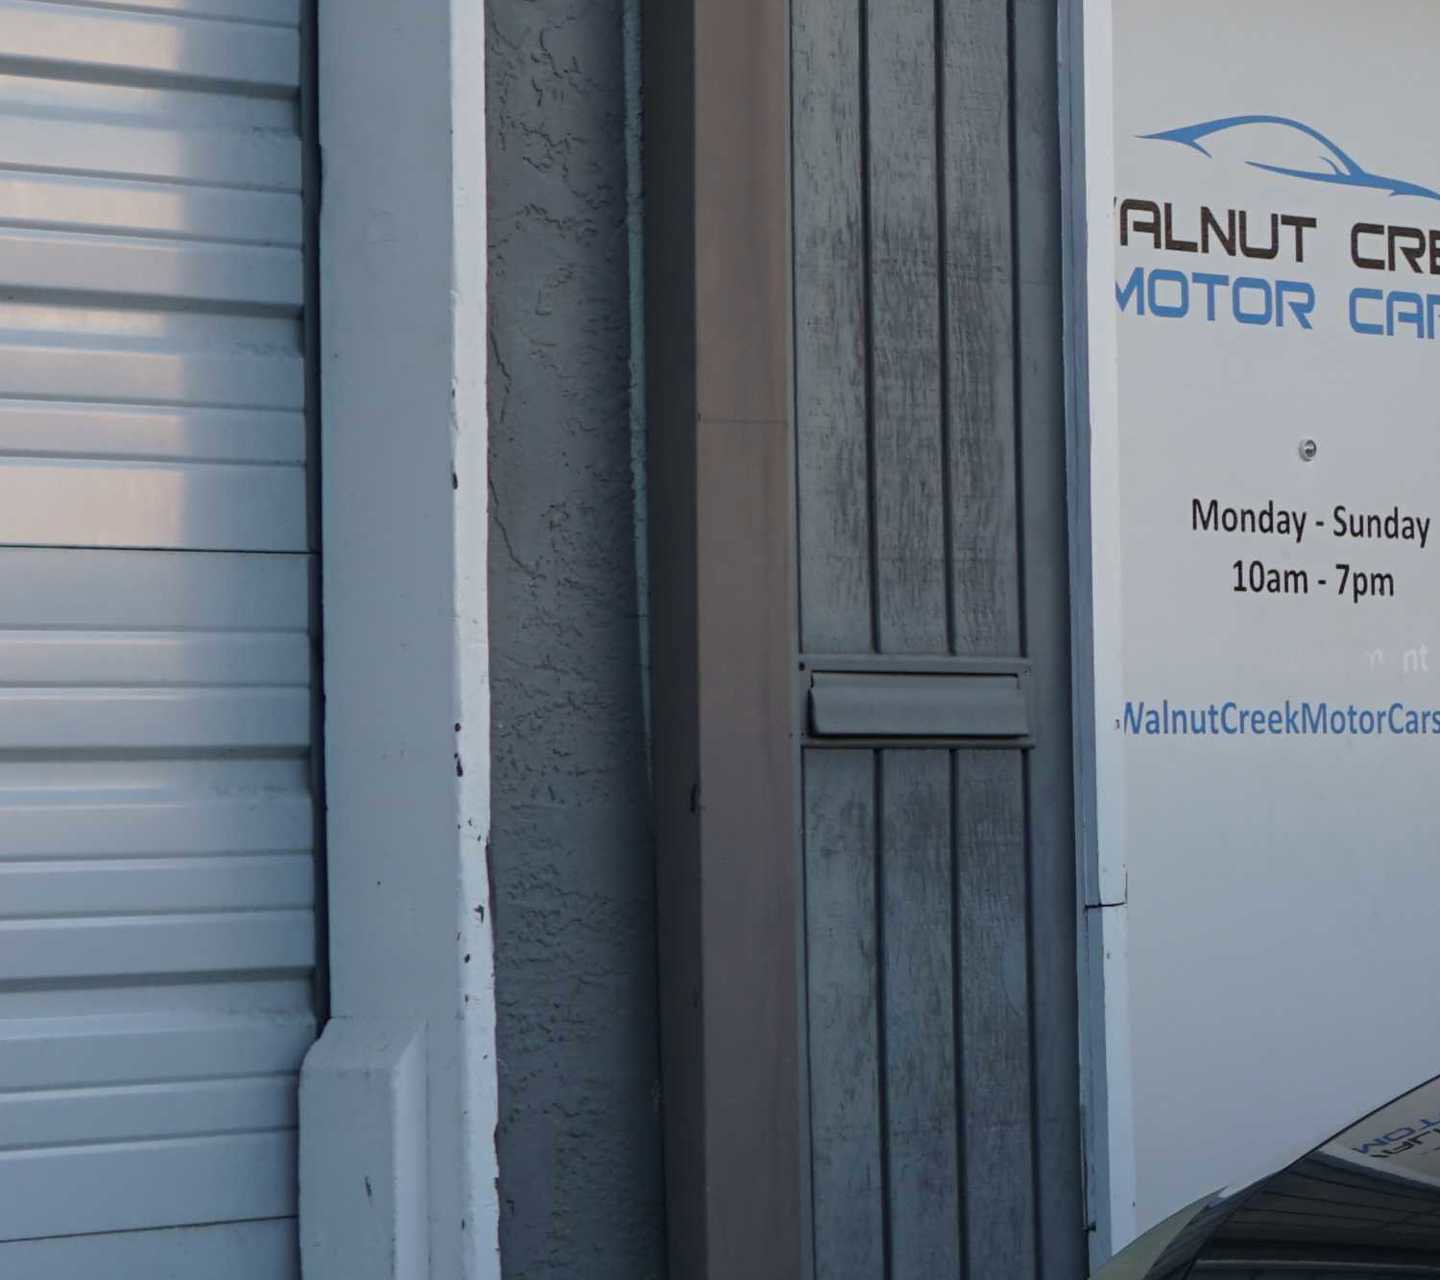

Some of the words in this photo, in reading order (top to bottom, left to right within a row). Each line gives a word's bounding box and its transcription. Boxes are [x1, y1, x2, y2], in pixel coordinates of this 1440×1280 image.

[1113, 196, 1317, 263] ALNUT
[1191, 499, 1307, 542] Monday
[1332, 505, 1430, 548] Sunday
[1232, 560, 1308, 593] 10am
[1335, 564, 1395, 601] 7pm
